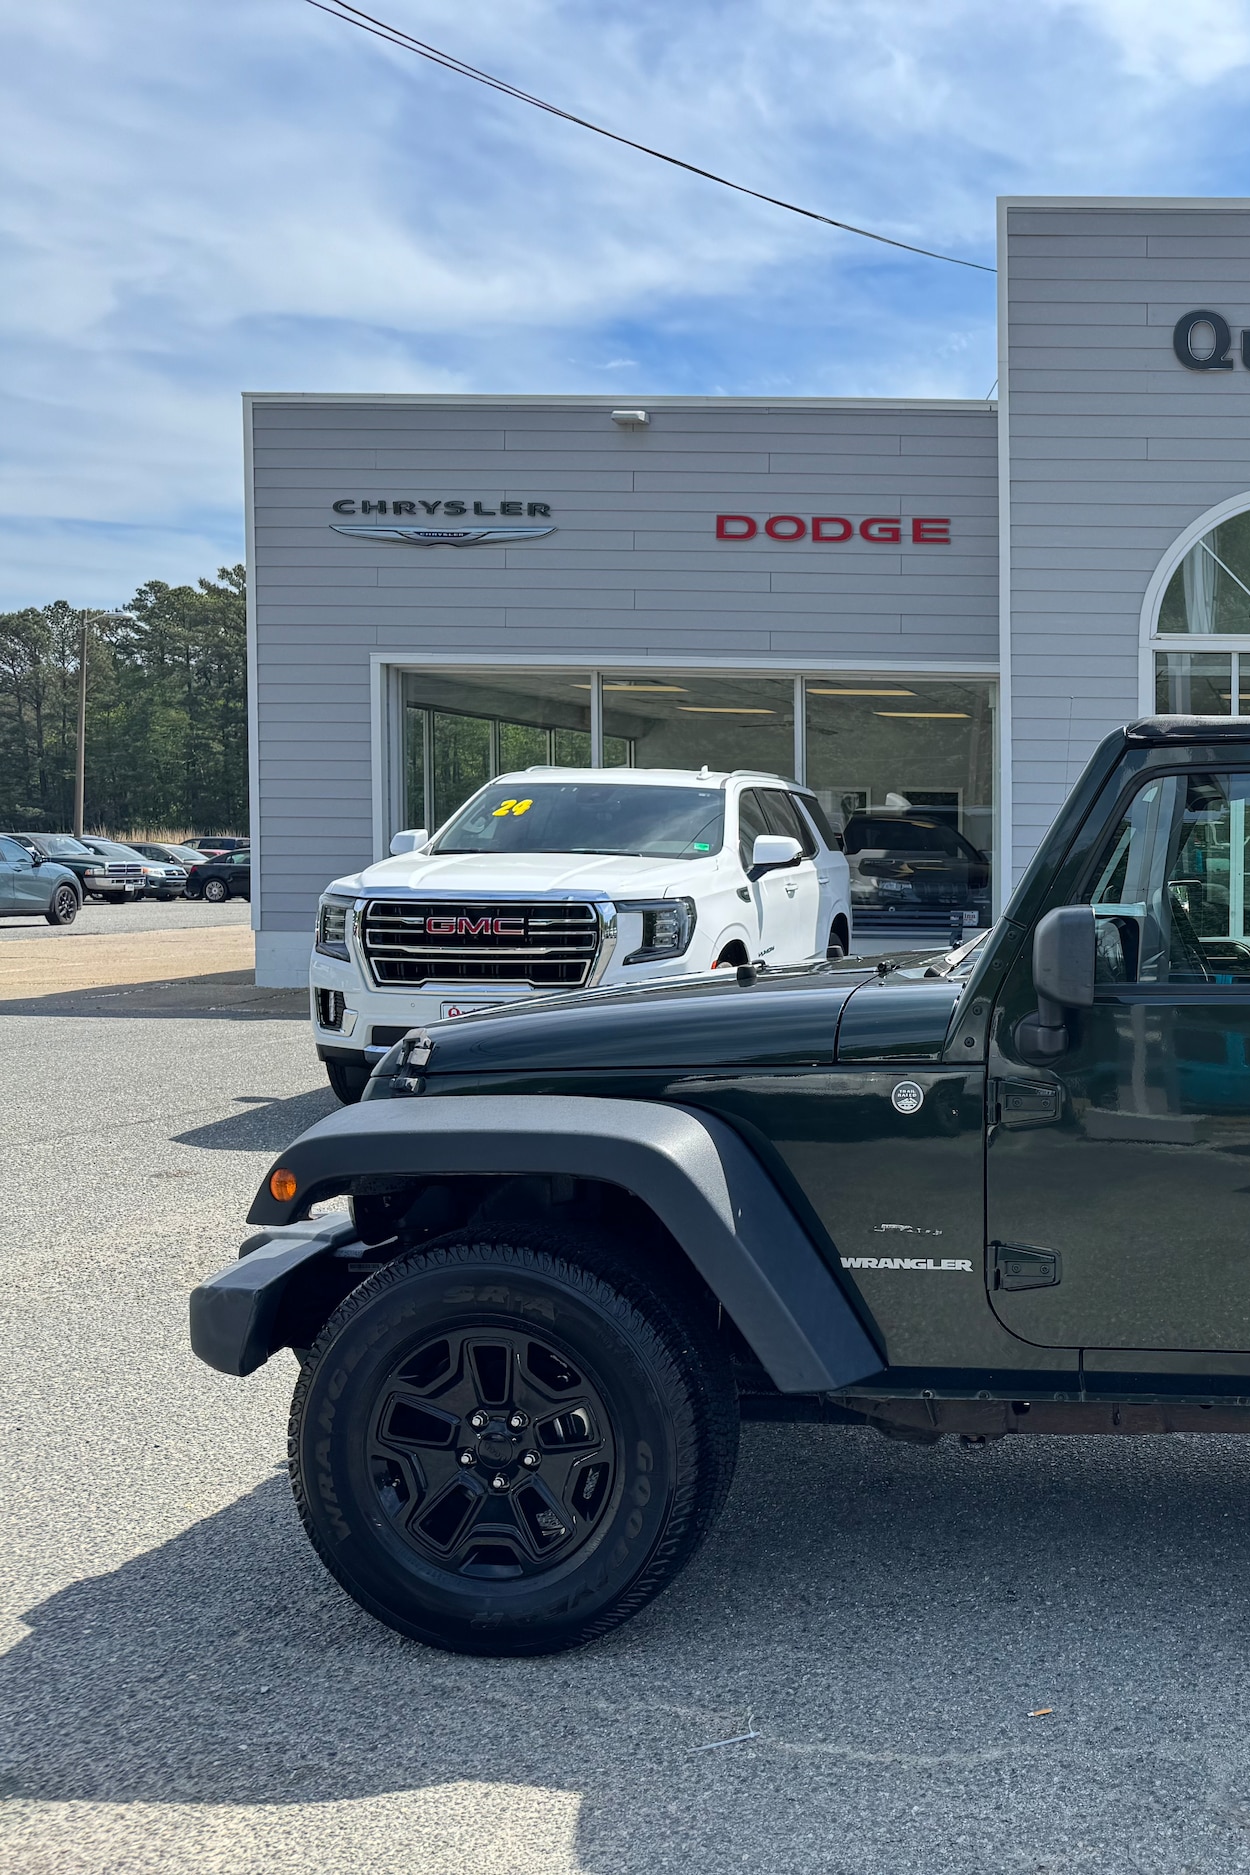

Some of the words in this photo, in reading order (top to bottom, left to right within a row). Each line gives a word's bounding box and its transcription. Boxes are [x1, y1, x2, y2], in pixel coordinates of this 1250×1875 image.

[331, 498, 552, 518] CHRYSLER
[714, 513, 952, 545] DODGE
[491, 799, 534, 817] 24
[425, 916, 525, 935] GMC
[840, 1256, 974, 1273] WRANGLER
